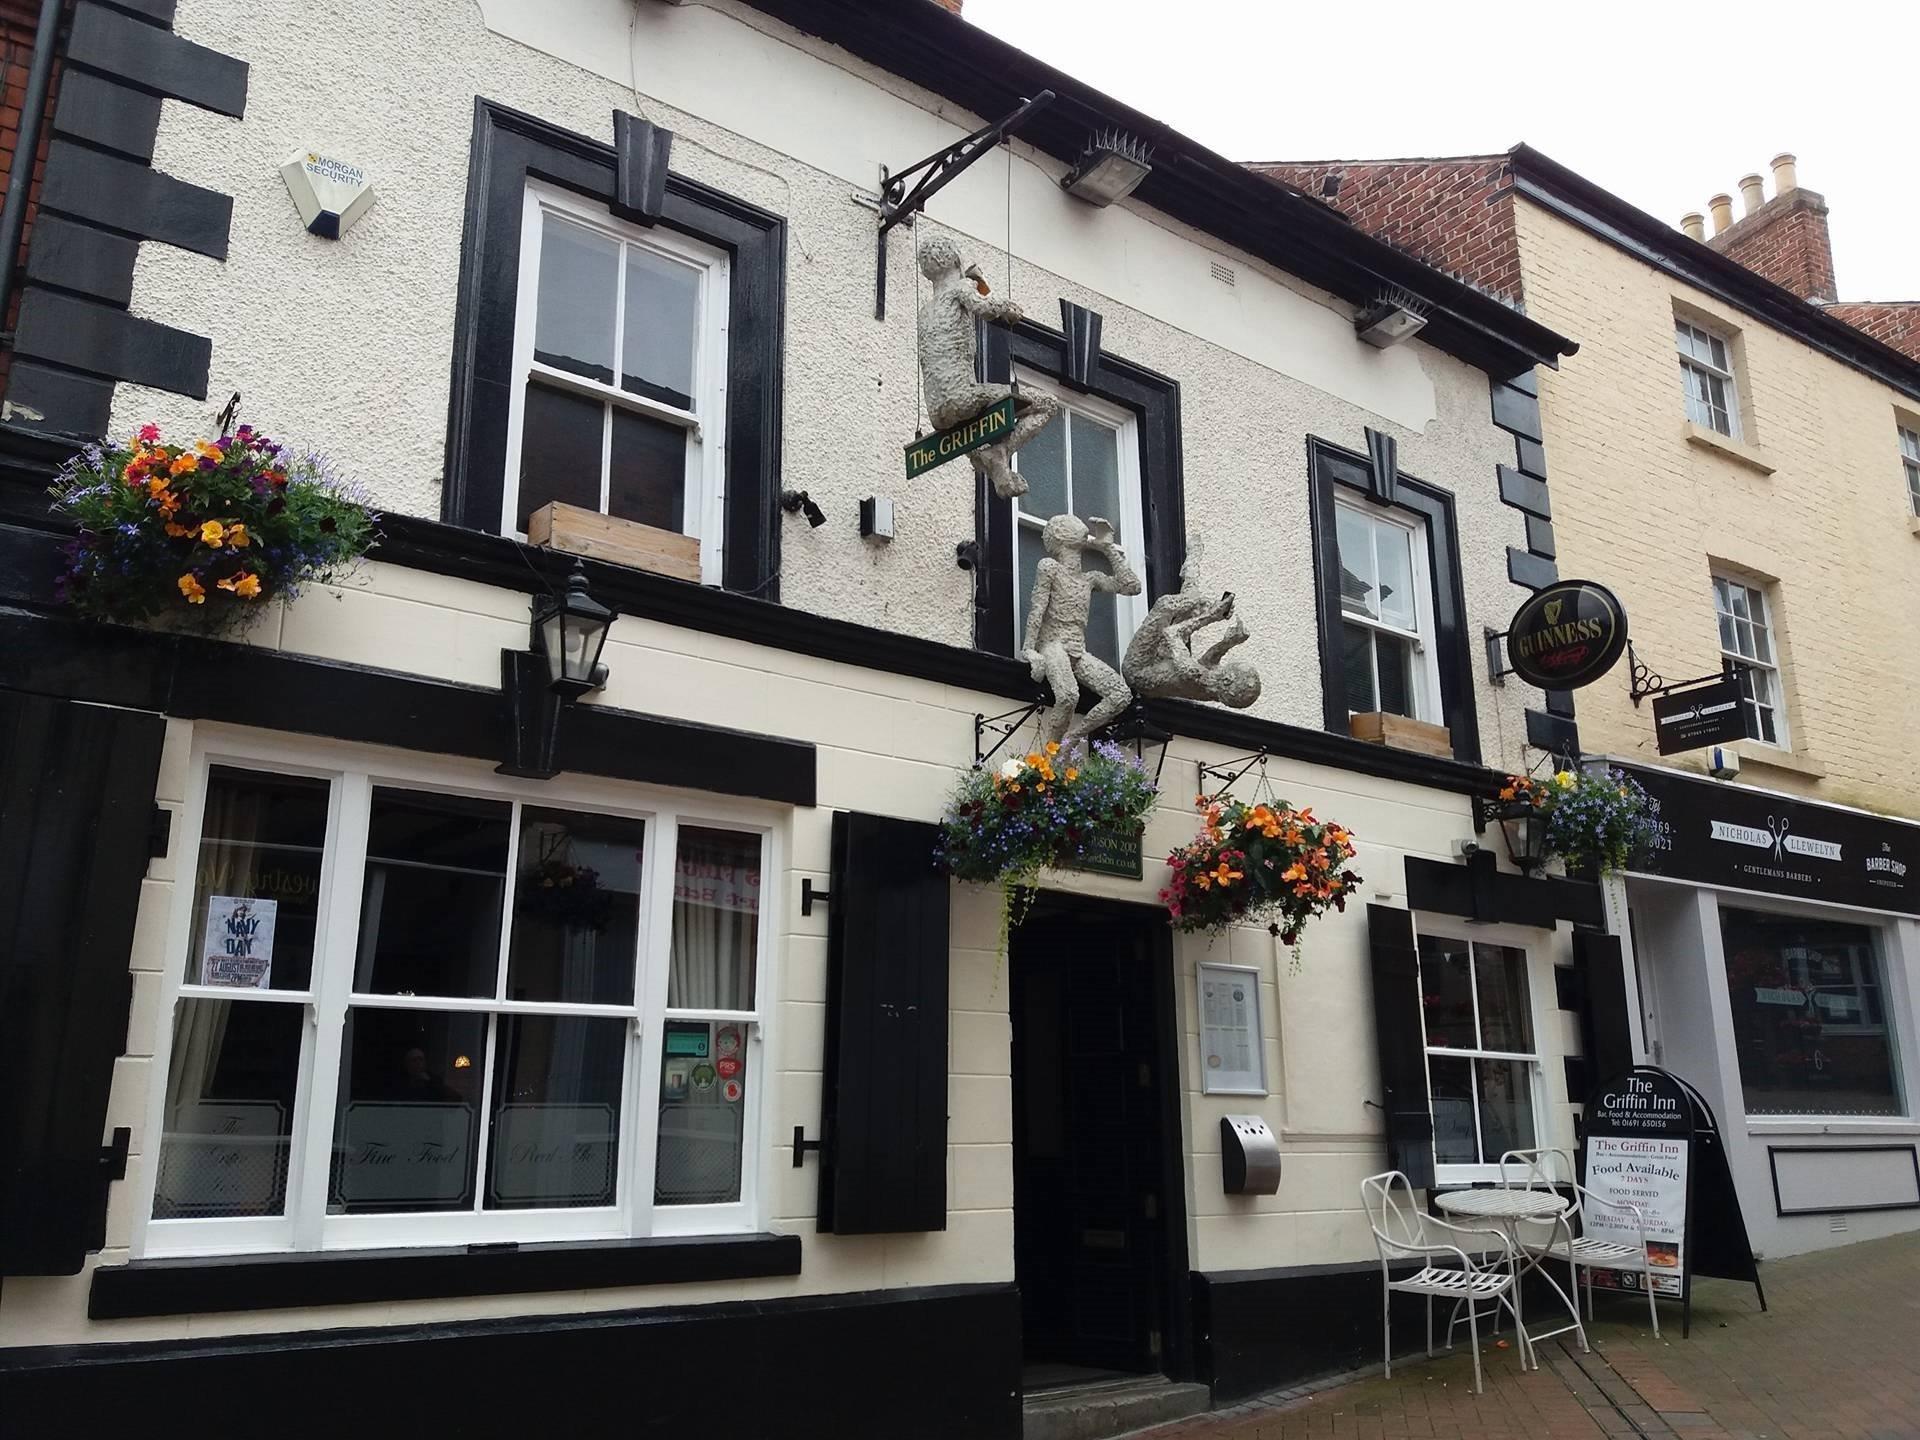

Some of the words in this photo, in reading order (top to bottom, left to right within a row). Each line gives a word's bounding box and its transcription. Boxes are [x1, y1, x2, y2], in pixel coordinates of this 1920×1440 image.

[306, 163, 362, 187] SECURITY
[318, 157, 363, 179] MORGAN
[910, 448, 936, 470] The
[940, 408, 1006, 455] GRIFFIN
[1520, 617, 1602, 657] GUINNESS
[1719, 826, 1767, 844] NICHOLAS
[1791, 839, 1835, 857] LLEWELYN
[1866, 857, 1890, 871] BARBER
[1891, 860, 1906, 877] SHOP
[1786, 870, 1812, 882] BARBERS
[227, 918, 260, 938] NAVY
[225, 938, 253, 956] DAY
[719, 1061, 735, 1071] PRS
[1627, 1077, 1653, 1093] The
[1603, 1093, 1647, 1110] Griffin
[1653, 1094, 1676, 1110] Inn
[1608, 1110, 1623, 1118] Food
[1632, 1111, 1681, 1120] Accommodation
[1622, 1119, 1639, 1127] 01691
[1642, 1120, 1666, 1128] 650156
[1595, 1140, 1617, 1150] The
[1620, 1141, 1656, 1153] Griffin
[1660, 1143, 1679, 1154] Inn
[1592, 1162, 1622, 1175] Food
[1626, 1162, 1679, 1180] Available
[1626, 1176, 1648, 1184] DAYS
[1609, 1187, 1630, 1196] FOOD
[1616, 1199, 1649, 1208] MONDAY
[1594, 1214, 1625, 1223] TUESDAY
[1632, 1217, 1668, 1227] SAURDAY
